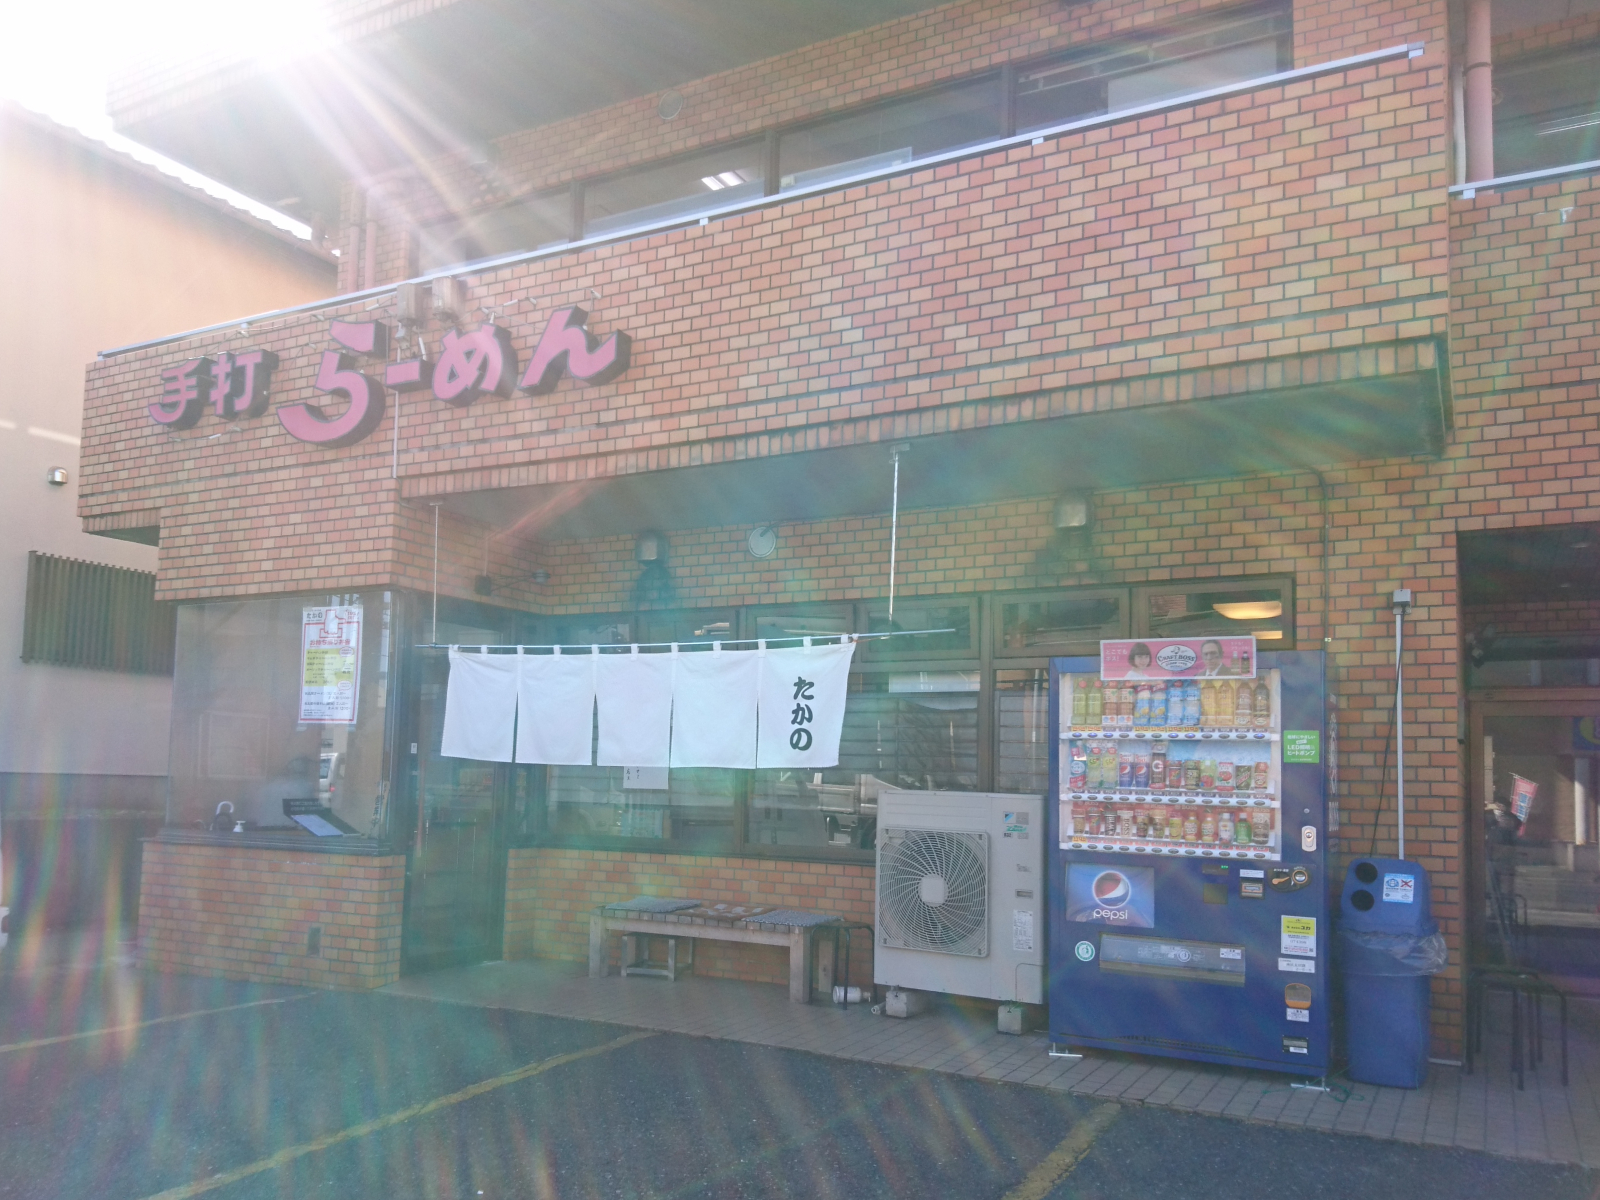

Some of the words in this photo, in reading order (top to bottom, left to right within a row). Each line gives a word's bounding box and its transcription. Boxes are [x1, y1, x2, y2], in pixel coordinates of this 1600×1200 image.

[147, 350, 272, 428] 手打
[276, 305, 630, 446] らーめん
[1105, 648, 1128, 656] どこでも
[1178, 654, 1196, 662] BOSS
[789, 676, 815, 752] たかの
[1123, 818, 1131, 836] BOSS
[1093, 908, 1128, 921] pepsi
